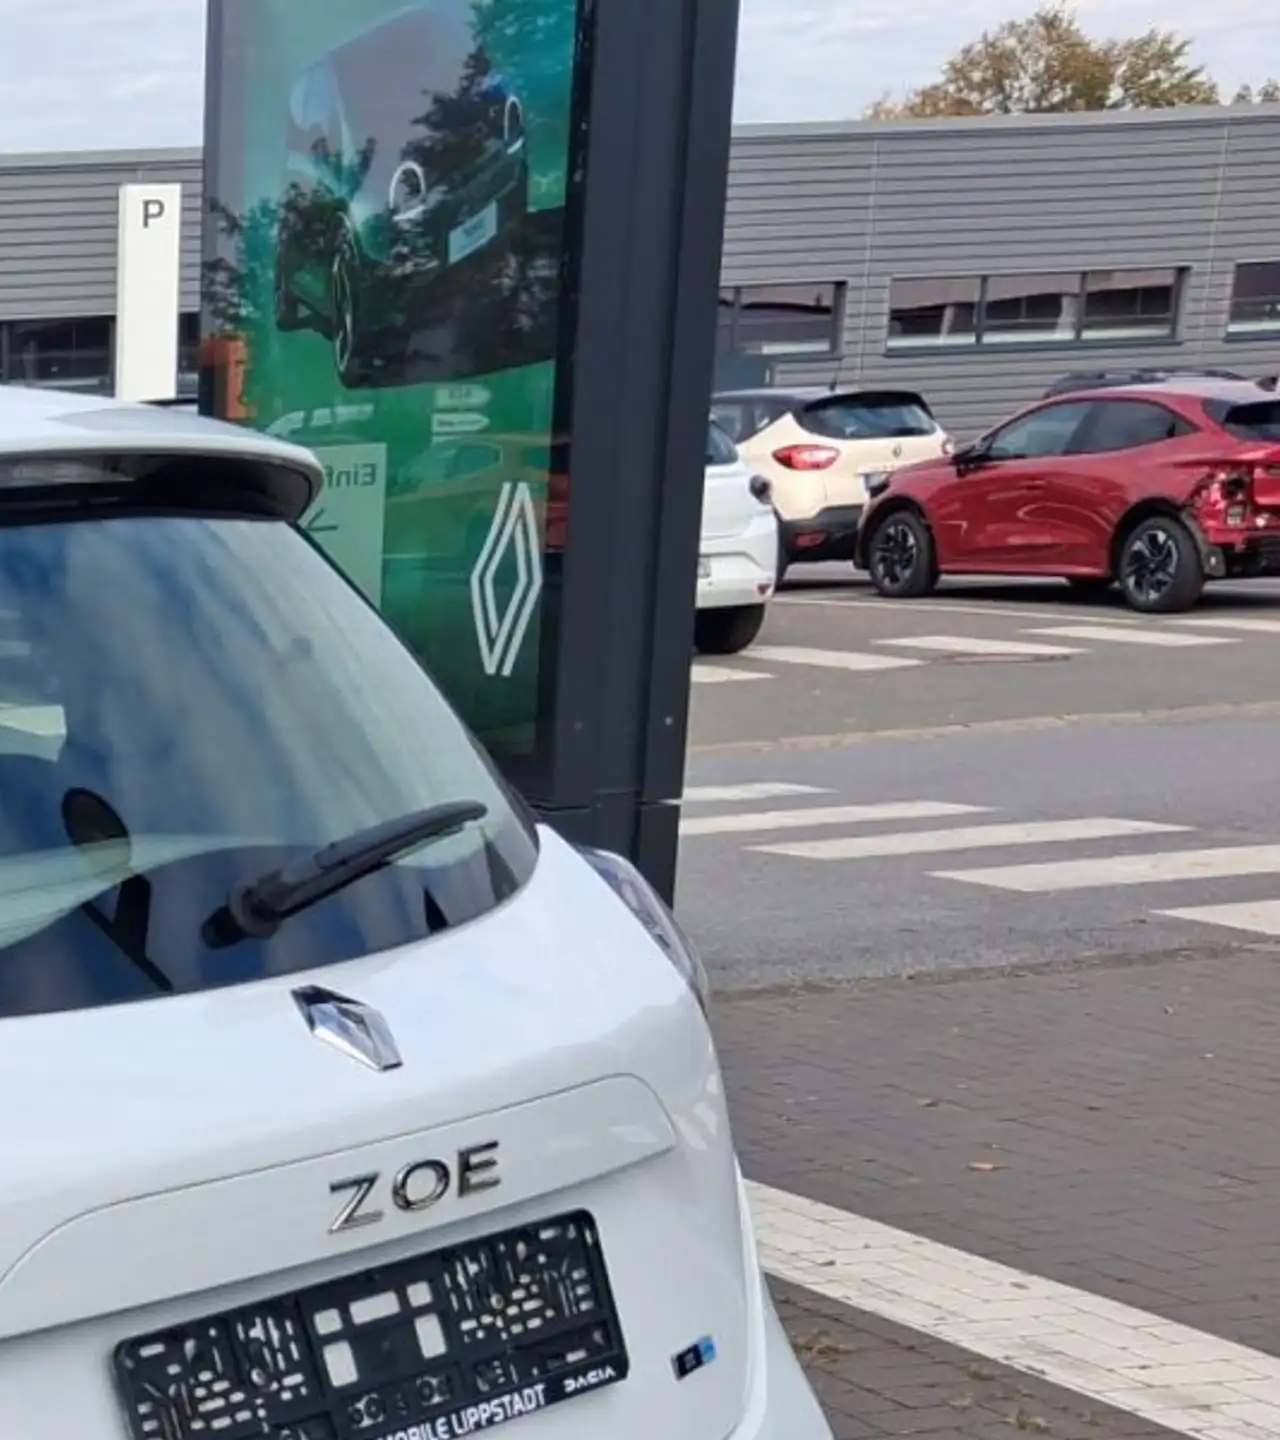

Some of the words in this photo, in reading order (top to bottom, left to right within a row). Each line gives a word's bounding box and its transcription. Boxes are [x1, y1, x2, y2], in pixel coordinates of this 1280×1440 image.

[143, 199, 165, 229] P
[328, 1140, 501, 1235] ZOE
[562, 1365, 617, 1393] DACIA
[451, 1383, 547, 1435] LIPPSTADT
